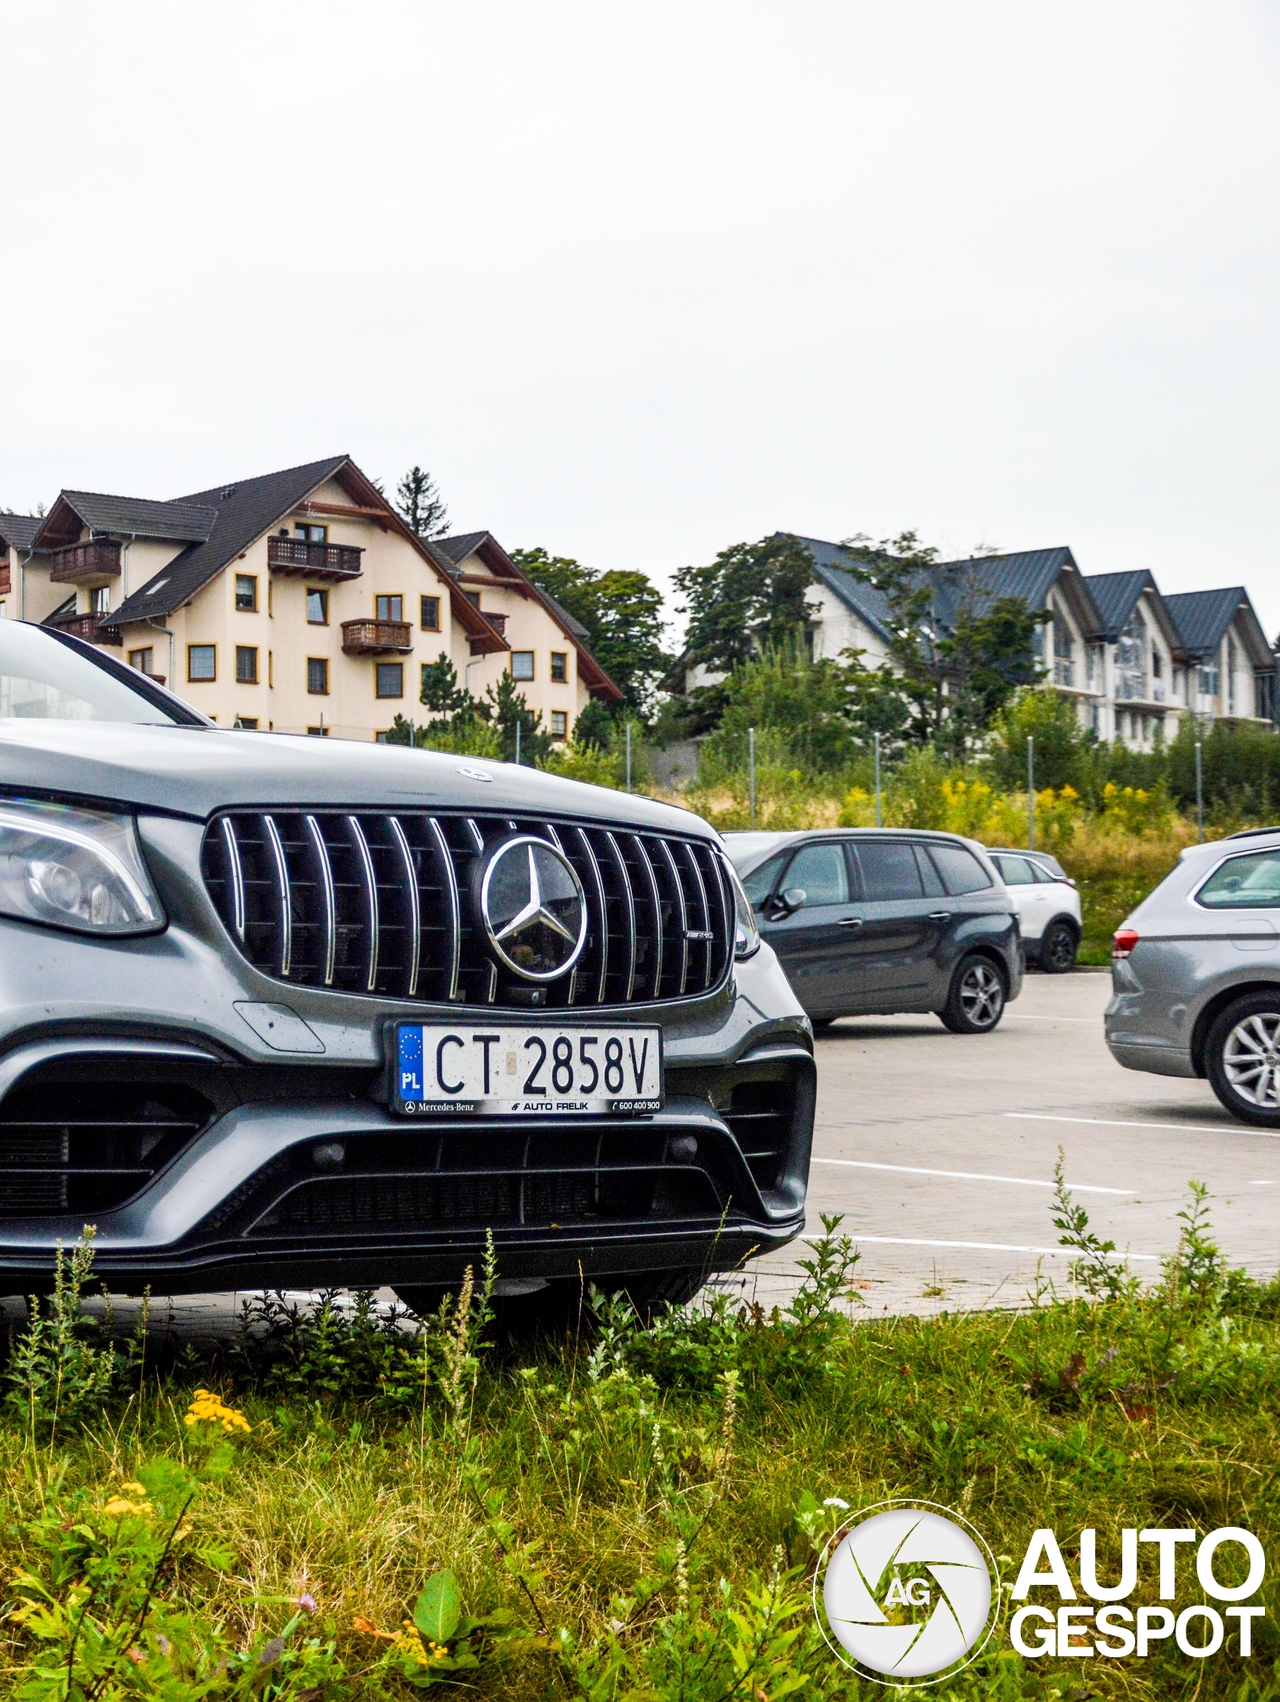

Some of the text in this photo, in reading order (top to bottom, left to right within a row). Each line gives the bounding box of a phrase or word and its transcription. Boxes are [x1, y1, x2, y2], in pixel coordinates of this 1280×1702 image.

[436, 1034, 649, 1095] CT 2858V
[402, 1072, 420, 1089] PL
[418, 1102, 474, 1112] Mercedes-Benz
[523, 1102, 588, 1110] AUTO FRELIK
[619, 1101, 660, 1110] 600 400 900
